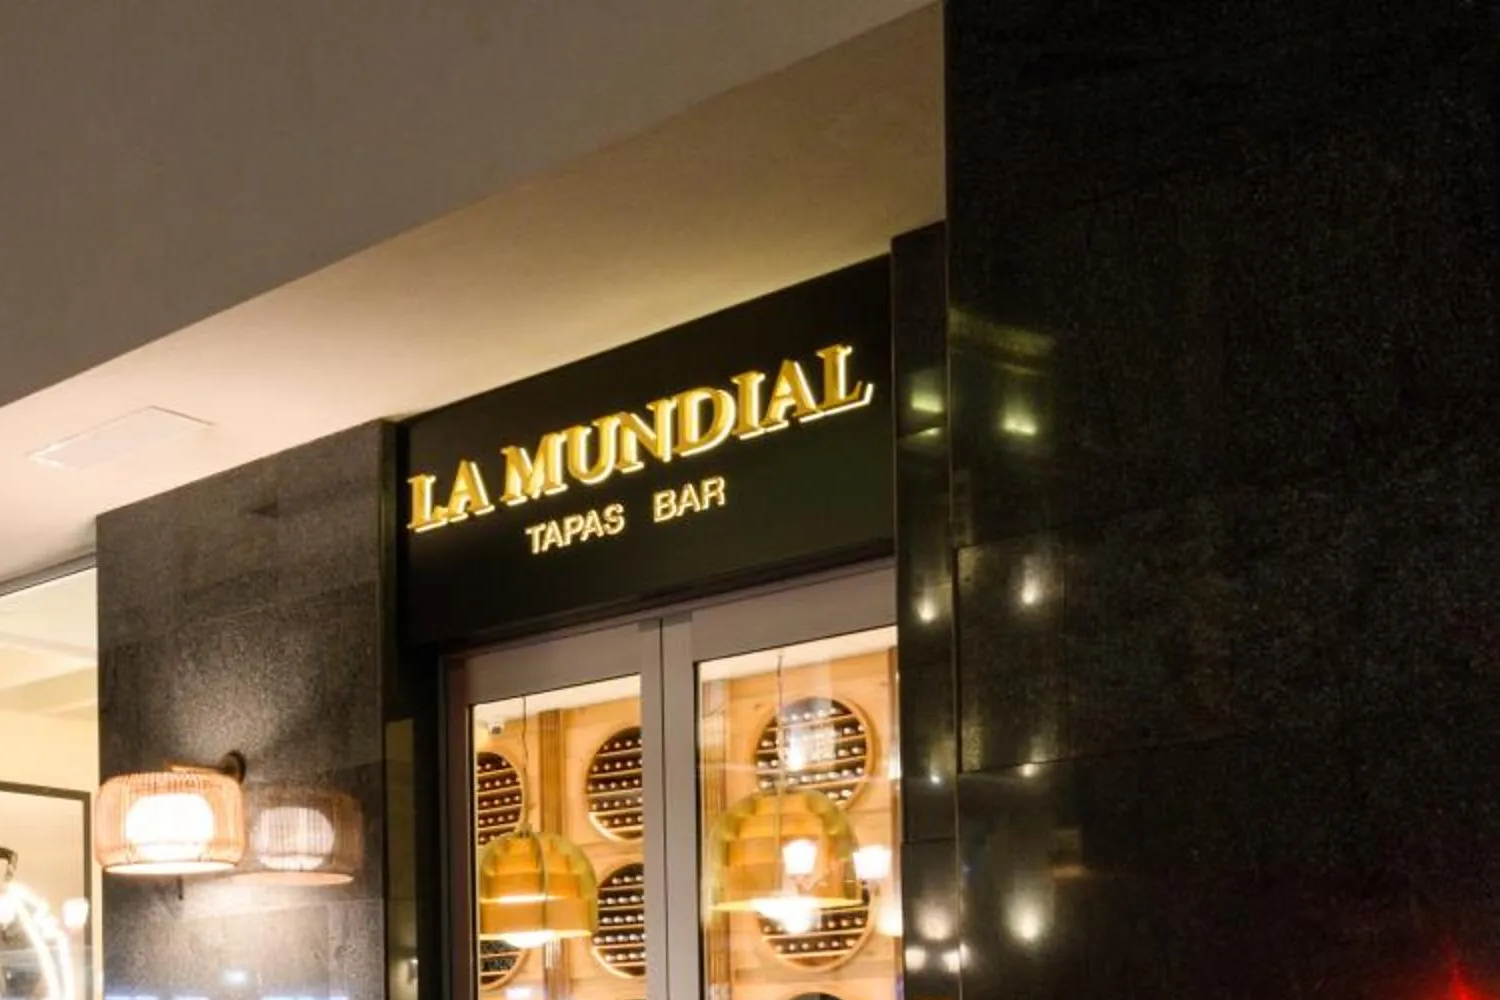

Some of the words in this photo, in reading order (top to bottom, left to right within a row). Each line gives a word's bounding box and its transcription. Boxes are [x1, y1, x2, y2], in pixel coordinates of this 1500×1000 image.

[407, 459, 495, 533] LA
[499, 343, 874, 508] MUNDIAL
[525, 502, 626, 555] TAPAS
[652, 475, 727, 524] BAR
